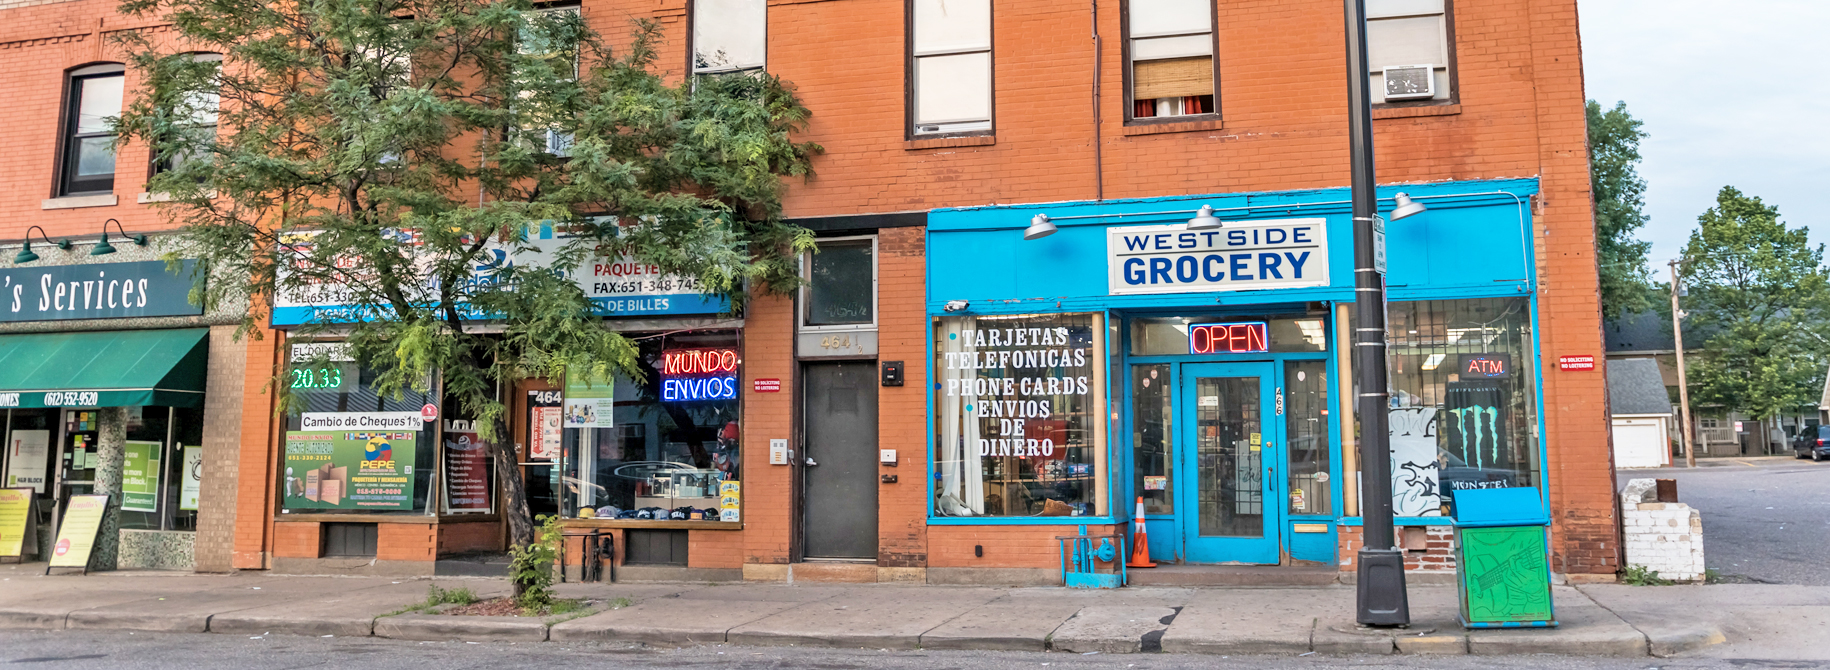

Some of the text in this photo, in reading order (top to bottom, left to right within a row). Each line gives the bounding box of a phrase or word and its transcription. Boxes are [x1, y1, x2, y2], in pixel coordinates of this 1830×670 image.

[1123, 251, 1311, 286] GROCERY
[4, 271, 148, 313] 's Services
[608, 300, 625, 312] DE
[627, 298, 670, 312] BILLES
[820, 335, 851, 350] 464
[962, 326, 1067, 347] TARJETAS
[1192, 323, 1267, 354] OPEN
[664, 350, 736, 375] MUNDO
[945, 348, 1086, 370] TELEFONICAS
[1468, 359, 1503, 374] ATM
[291, 368, 342, 389] 20.33
[947, 376, 1088, 397] PHONE CARDS
[535, 391, 562, 404] 464
[663, 377, 735, 400] ENVIOS
[44, 392, 63, 406] (612)
[63, 392, 98, 406] 552-9520
[977, 400, 1051, 419] ENVIOS
[303, 416, 342, 427] Cambio
[344, 416, 357, 427] de
[359, 416, 405, 428] Cheques
[1000, 419, 1025, 437] DE
[978, 438, 1054, 457] DINERO
[360, 460, 396, 469] PEPE
